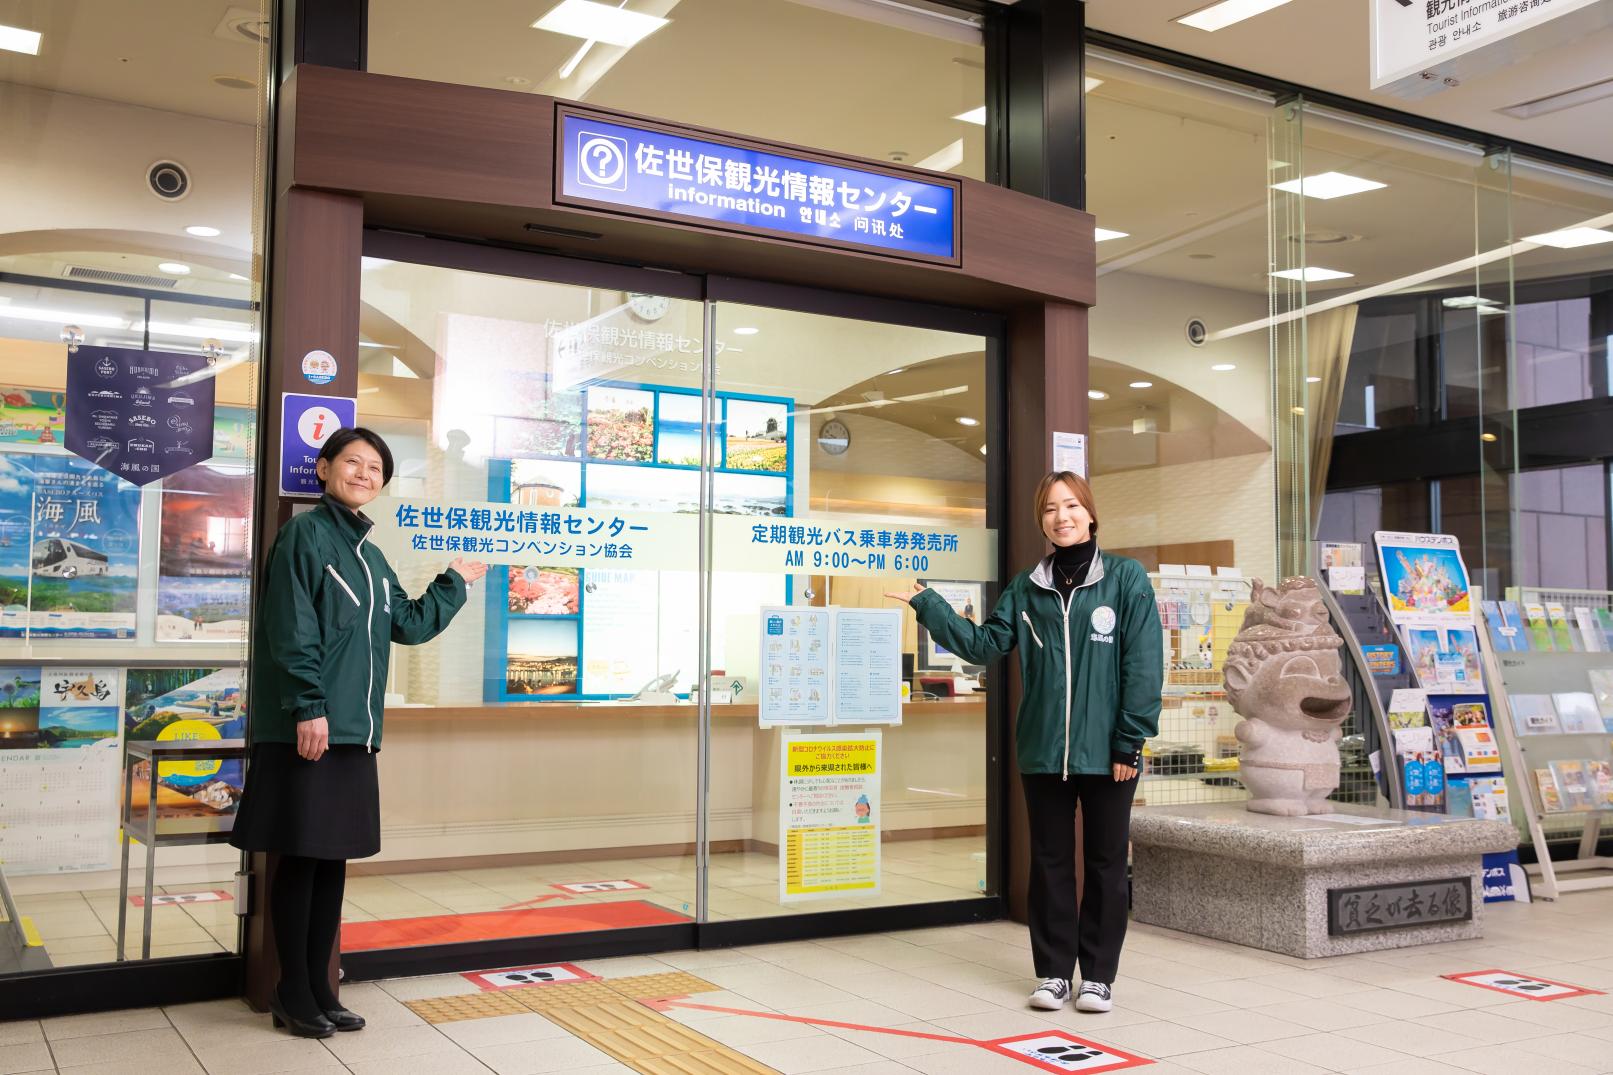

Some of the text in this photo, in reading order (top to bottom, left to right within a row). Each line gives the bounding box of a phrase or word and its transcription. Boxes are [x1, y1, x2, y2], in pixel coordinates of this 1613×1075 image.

[1427, 0, 1512, 35] Tourist Informati
[1428, 21, 1482, 51] 관광 안내소
[634, 142, 938, 218] 佐世保観光情報センター
[799, 206, 841, 230] 안내소
[854, 217, 904, 240] 问讯处
[289, 465, 318, 475] Infor
[303, 455, 318, 464] Tou
[37, 496, 101, 533] 海風
[395, 504, 649, 538] 佐世保観光情報センター
[412, 534, 633, 559] 佐世保観光コンベンション協会
[751, 524, 959, 552] 定期観光バス乗車券発売所
[785, 550, 804, 567] AM
[894, 555, 929, 572] 6:00
[53, 679, 111, 701] 宇久島
[1344, 887, 1462, 929] 貧乏が去る像
